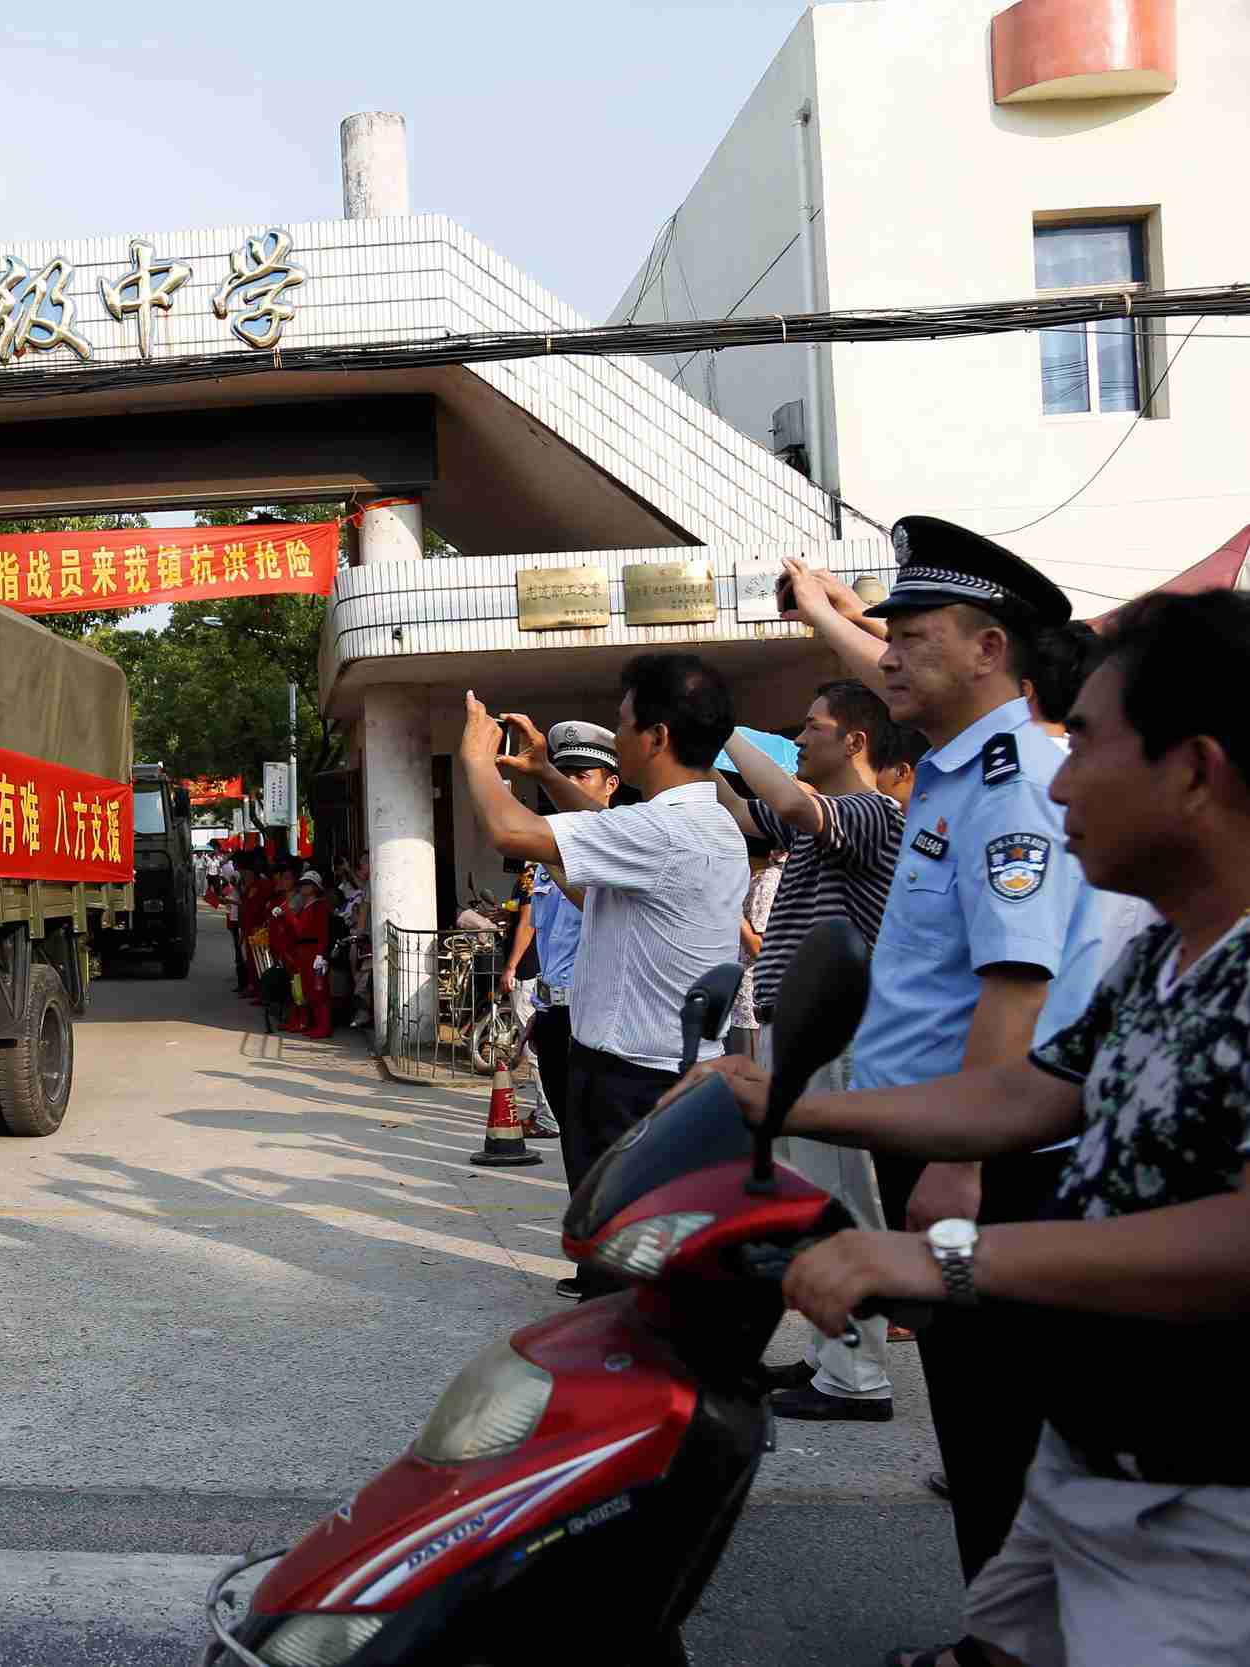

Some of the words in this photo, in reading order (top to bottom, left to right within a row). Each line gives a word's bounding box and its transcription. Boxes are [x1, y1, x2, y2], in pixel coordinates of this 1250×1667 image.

[54, 789, 122, 863] 八方支援
[405, 1511, 488, 1571] DAYUN
